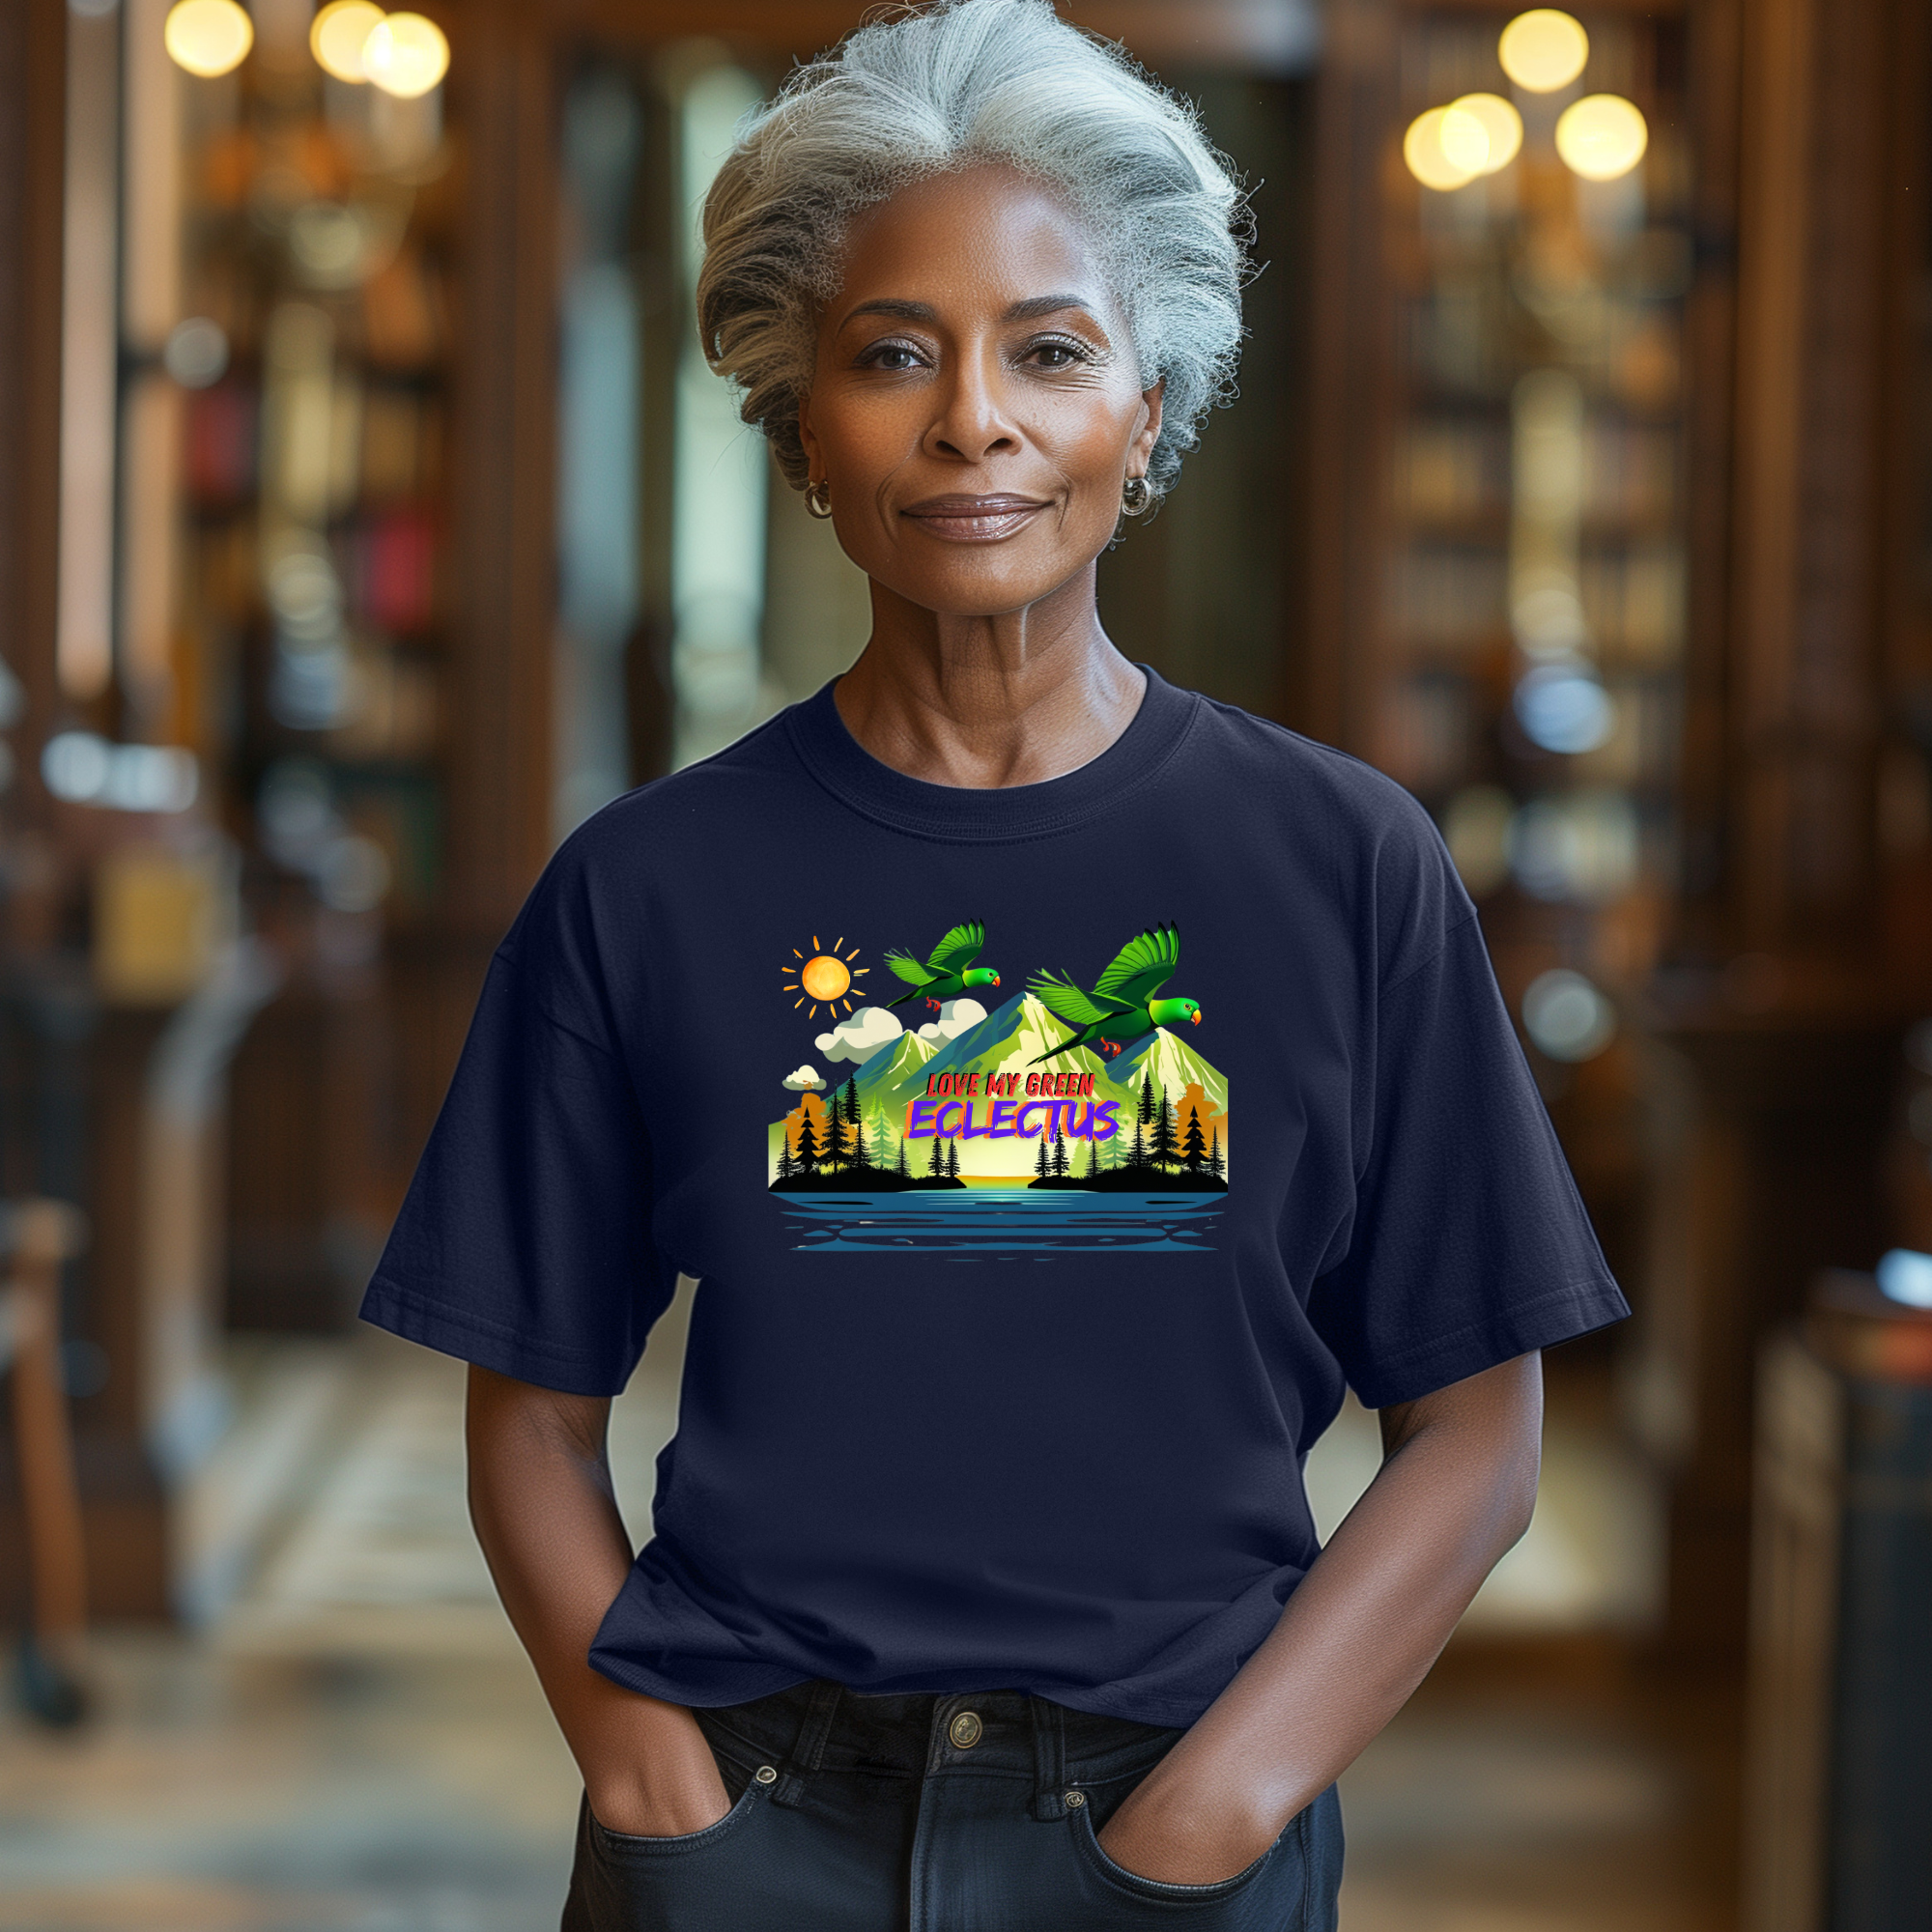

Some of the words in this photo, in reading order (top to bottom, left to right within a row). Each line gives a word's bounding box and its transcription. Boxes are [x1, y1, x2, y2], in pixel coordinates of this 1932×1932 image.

[926, 1072, 981, 1097] LOVE
[985, 1072, 1021, 1097] MY
[1025, 1072, 1095, 1097] GREEN
[903, 1099, 1122, 1144] ECLECTUS
